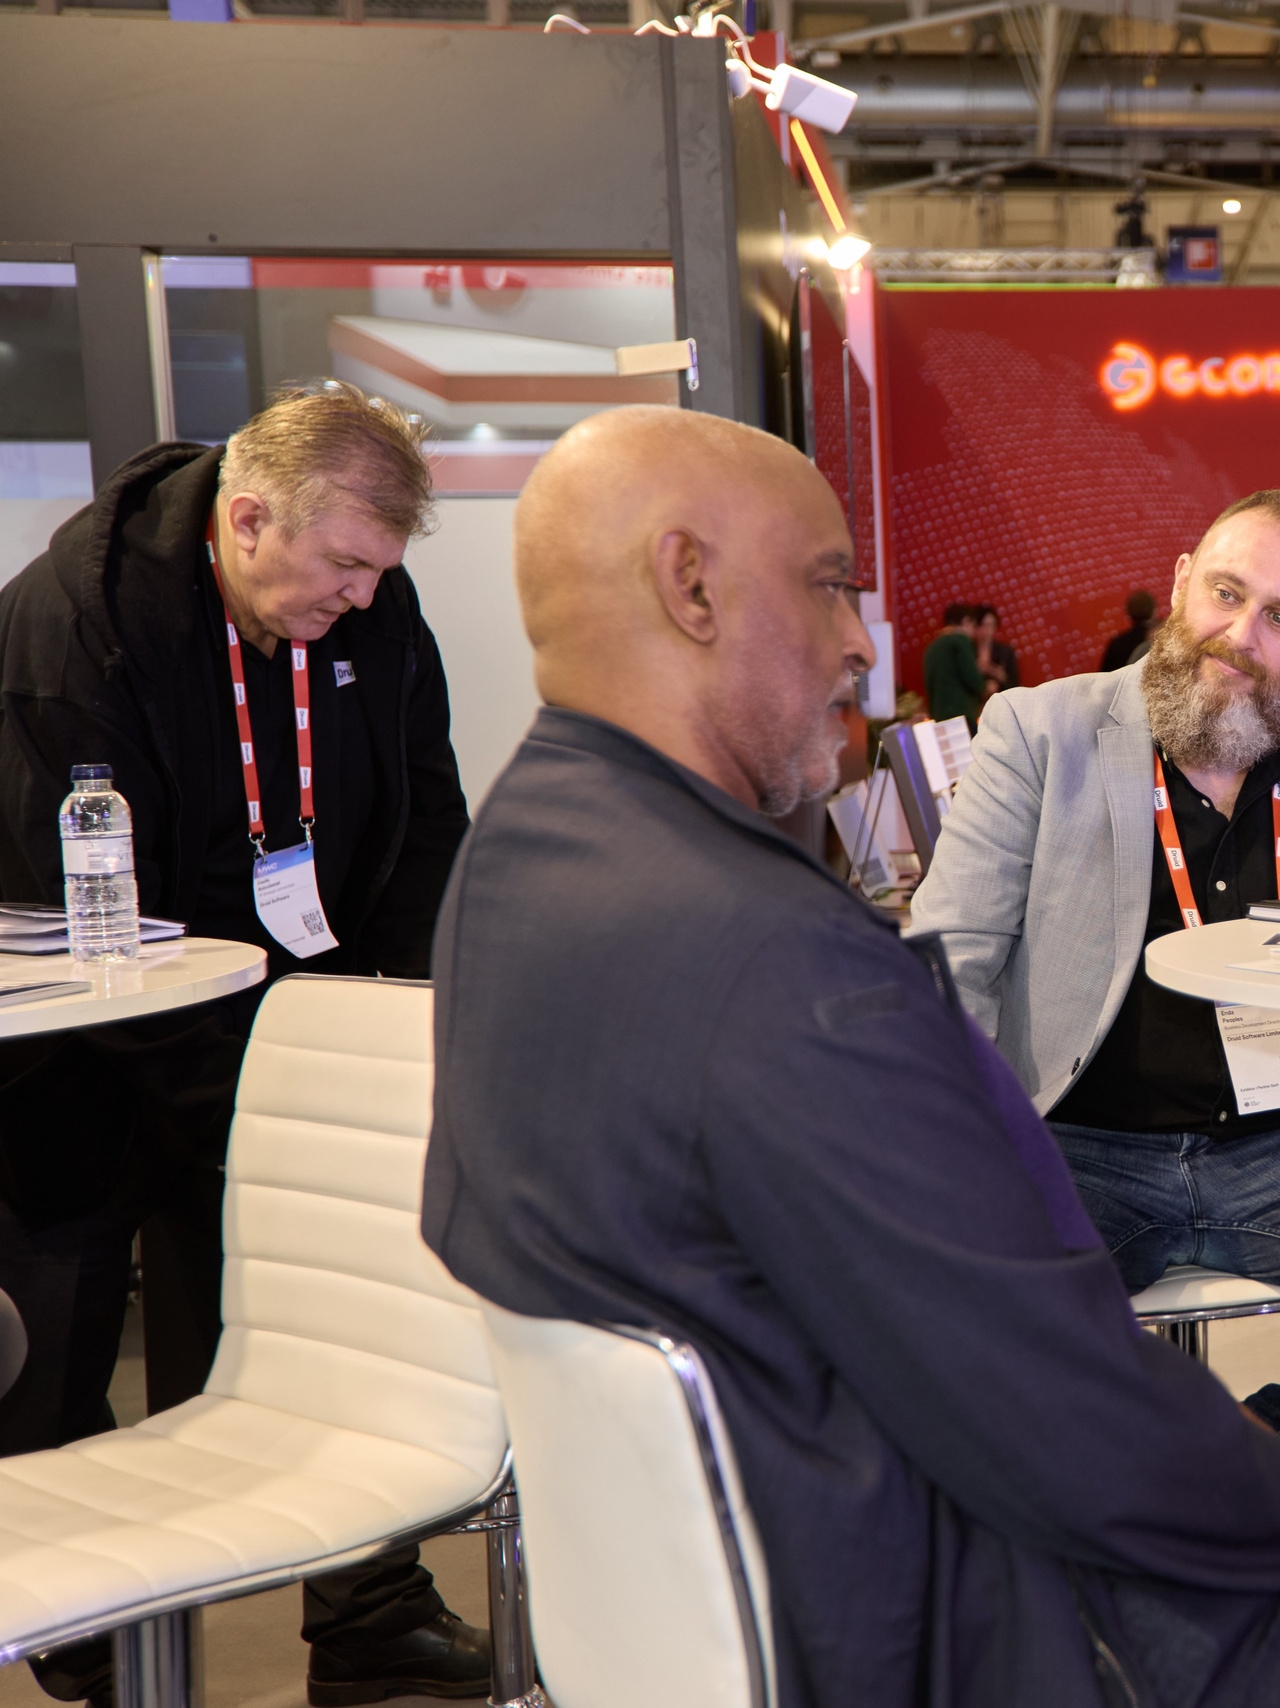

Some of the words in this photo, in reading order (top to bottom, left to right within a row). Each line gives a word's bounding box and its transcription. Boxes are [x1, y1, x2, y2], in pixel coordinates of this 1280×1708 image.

[1155, 789, 1164, 808] Druid
[1171, 850, 1180, 867] Druid
[257, 862, 278, 874] MWC
[1187, 911, 1198, 928] Druid
[1242, 1032, 1265, 1040] Software
